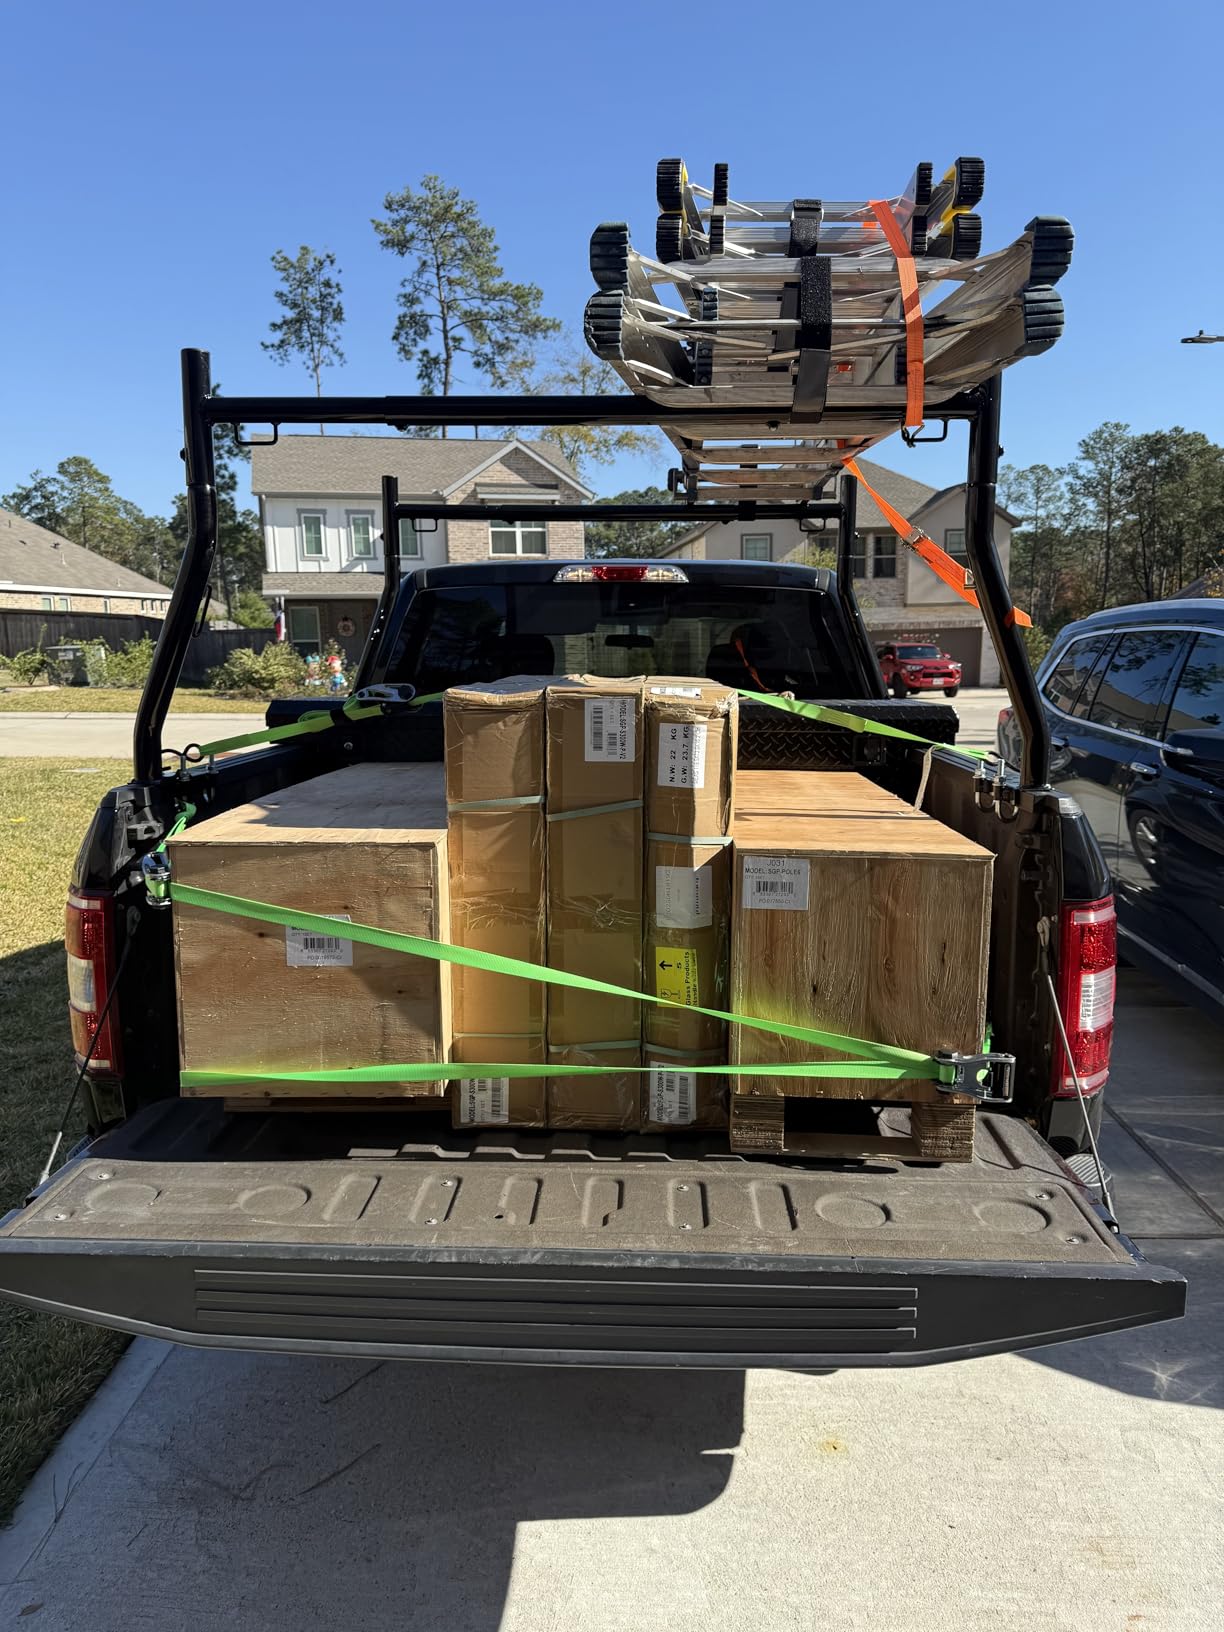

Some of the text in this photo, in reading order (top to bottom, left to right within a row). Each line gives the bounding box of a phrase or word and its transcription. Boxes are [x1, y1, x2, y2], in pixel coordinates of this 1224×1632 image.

[683, 726, 690, 739] KG
[668, 728, 677, 783] N.W: 22 KG
